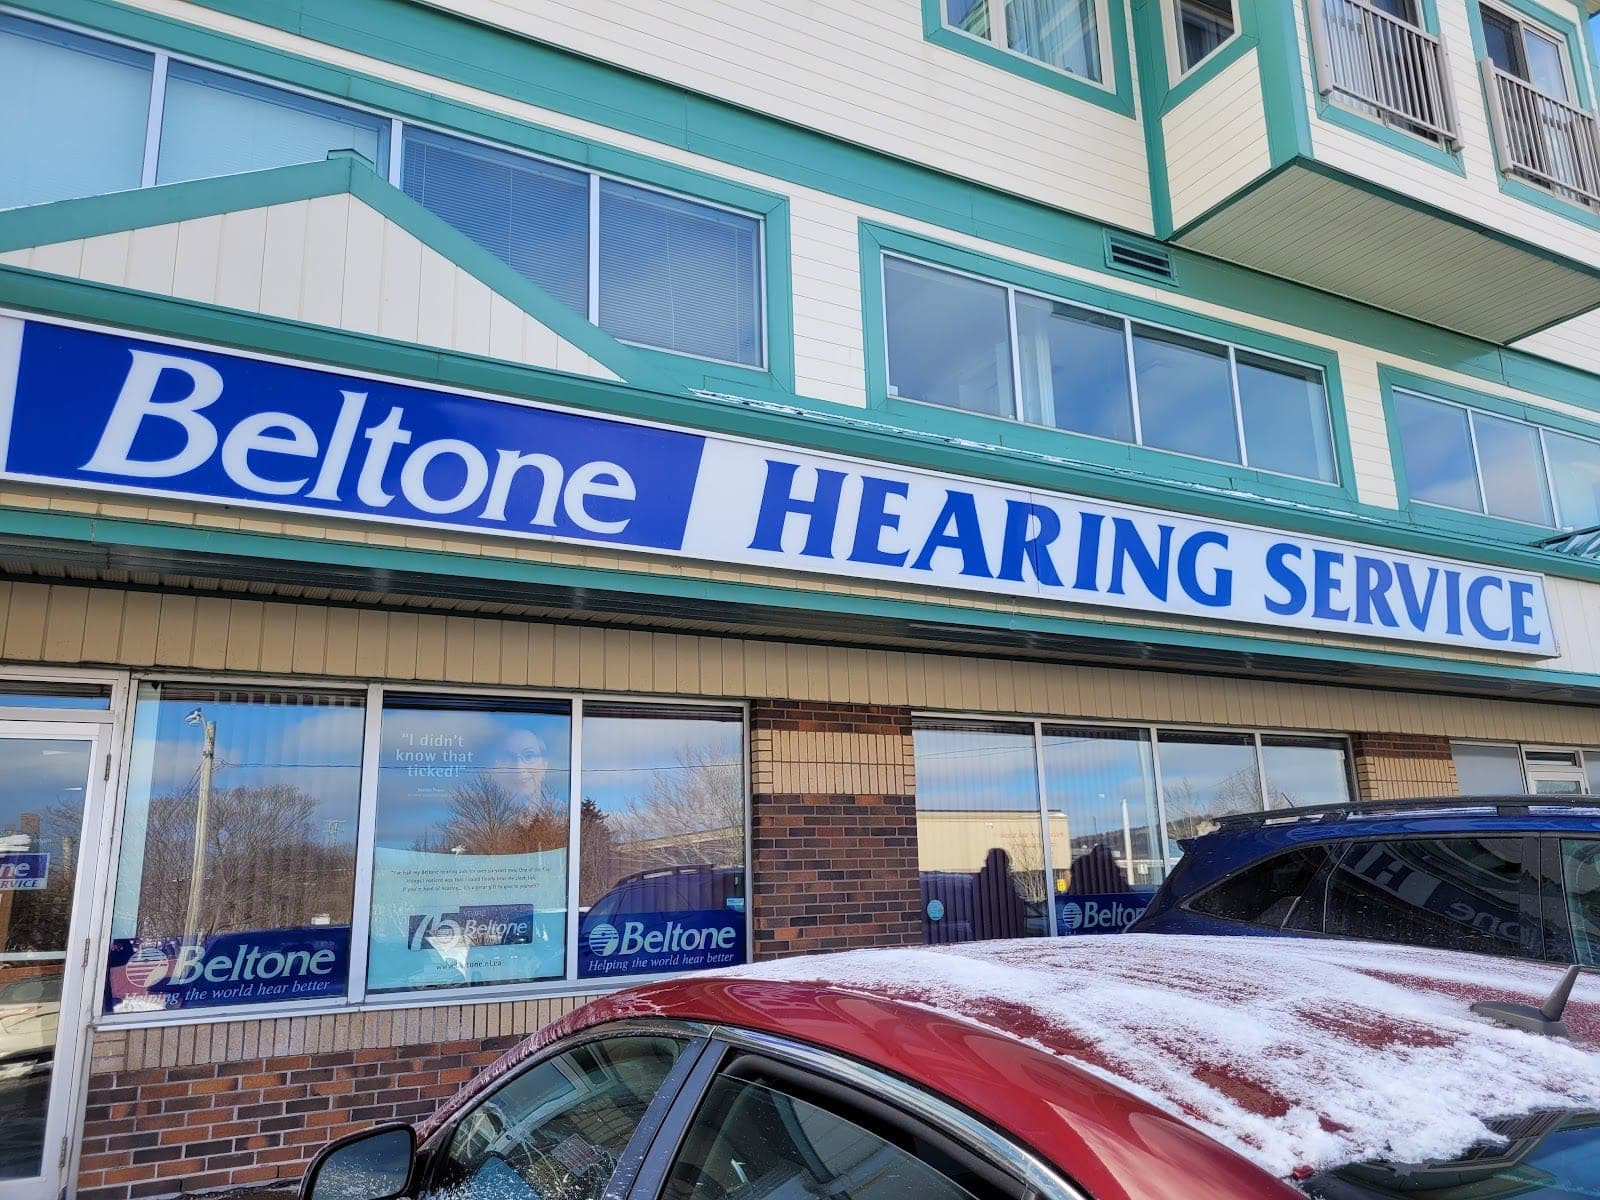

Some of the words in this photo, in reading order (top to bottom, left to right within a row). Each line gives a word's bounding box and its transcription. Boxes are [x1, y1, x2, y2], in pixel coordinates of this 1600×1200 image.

[78, 348, 637, 534] Beltone
[746, 459, 1233, 608] HEARING
[1264, 542, 1542, 646] SERVICE
[419, 732, 465, 748] didn't
[396, 748, 436, 762] know
[443, 749, 474, 763] that
[406, 764, 466, 777] ticked!"
[0, 880, 39, 888] RVICE
[1083, 901, 1146, 929] Belto
[463, 919, 528, 937] Beltone
[617, 921, 736, 956] Beltone
[166, 943, 336, 986] Beltone
[588, 959, 629, 973] Helping
[632, 957, 648, 968] the
[651, 955, 679, 967] world
[682, 952, 704, 965] hear
[707, 952, 734, 964] better
[185, 987, 207, 1001] the
[211, 986, 252, 999] world
[257, 982, 289, 995] hear
[292, 980, 331, 993] better
